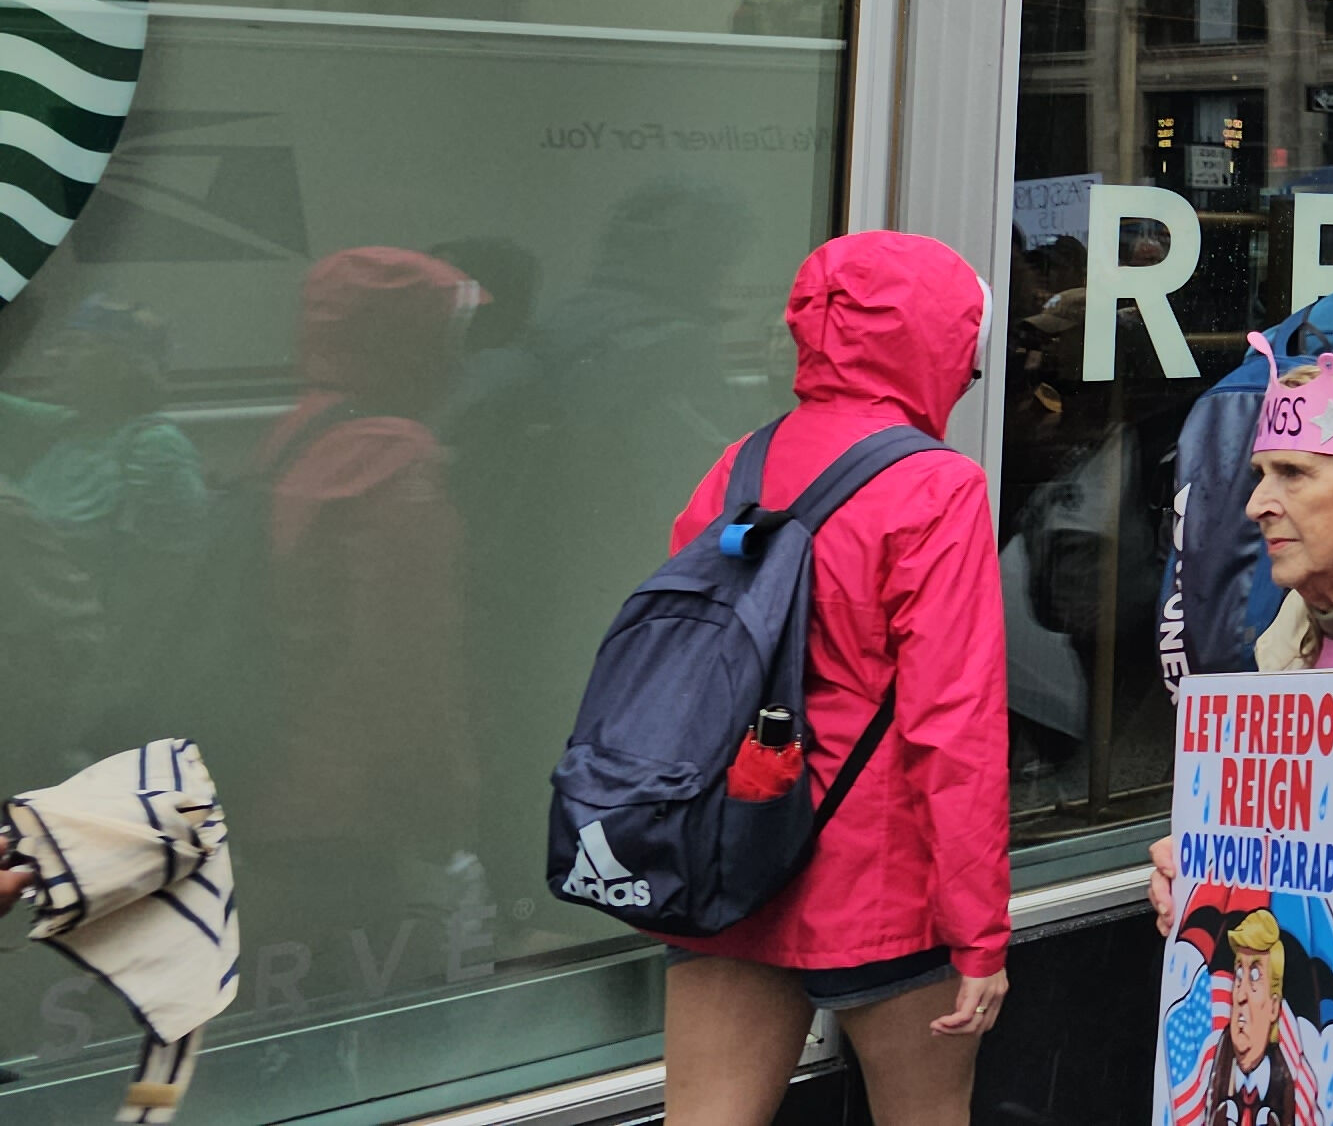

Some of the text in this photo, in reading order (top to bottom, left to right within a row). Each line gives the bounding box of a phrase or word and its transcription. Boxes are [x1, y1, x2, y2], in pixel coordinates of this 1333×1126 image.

[1183, 695, 1228, 753] LET
[1220, 757, 1313, 832] REIGN
[1180, 831, 1208, 879] ON
[1213, 833, 1263, 886] YOUR
